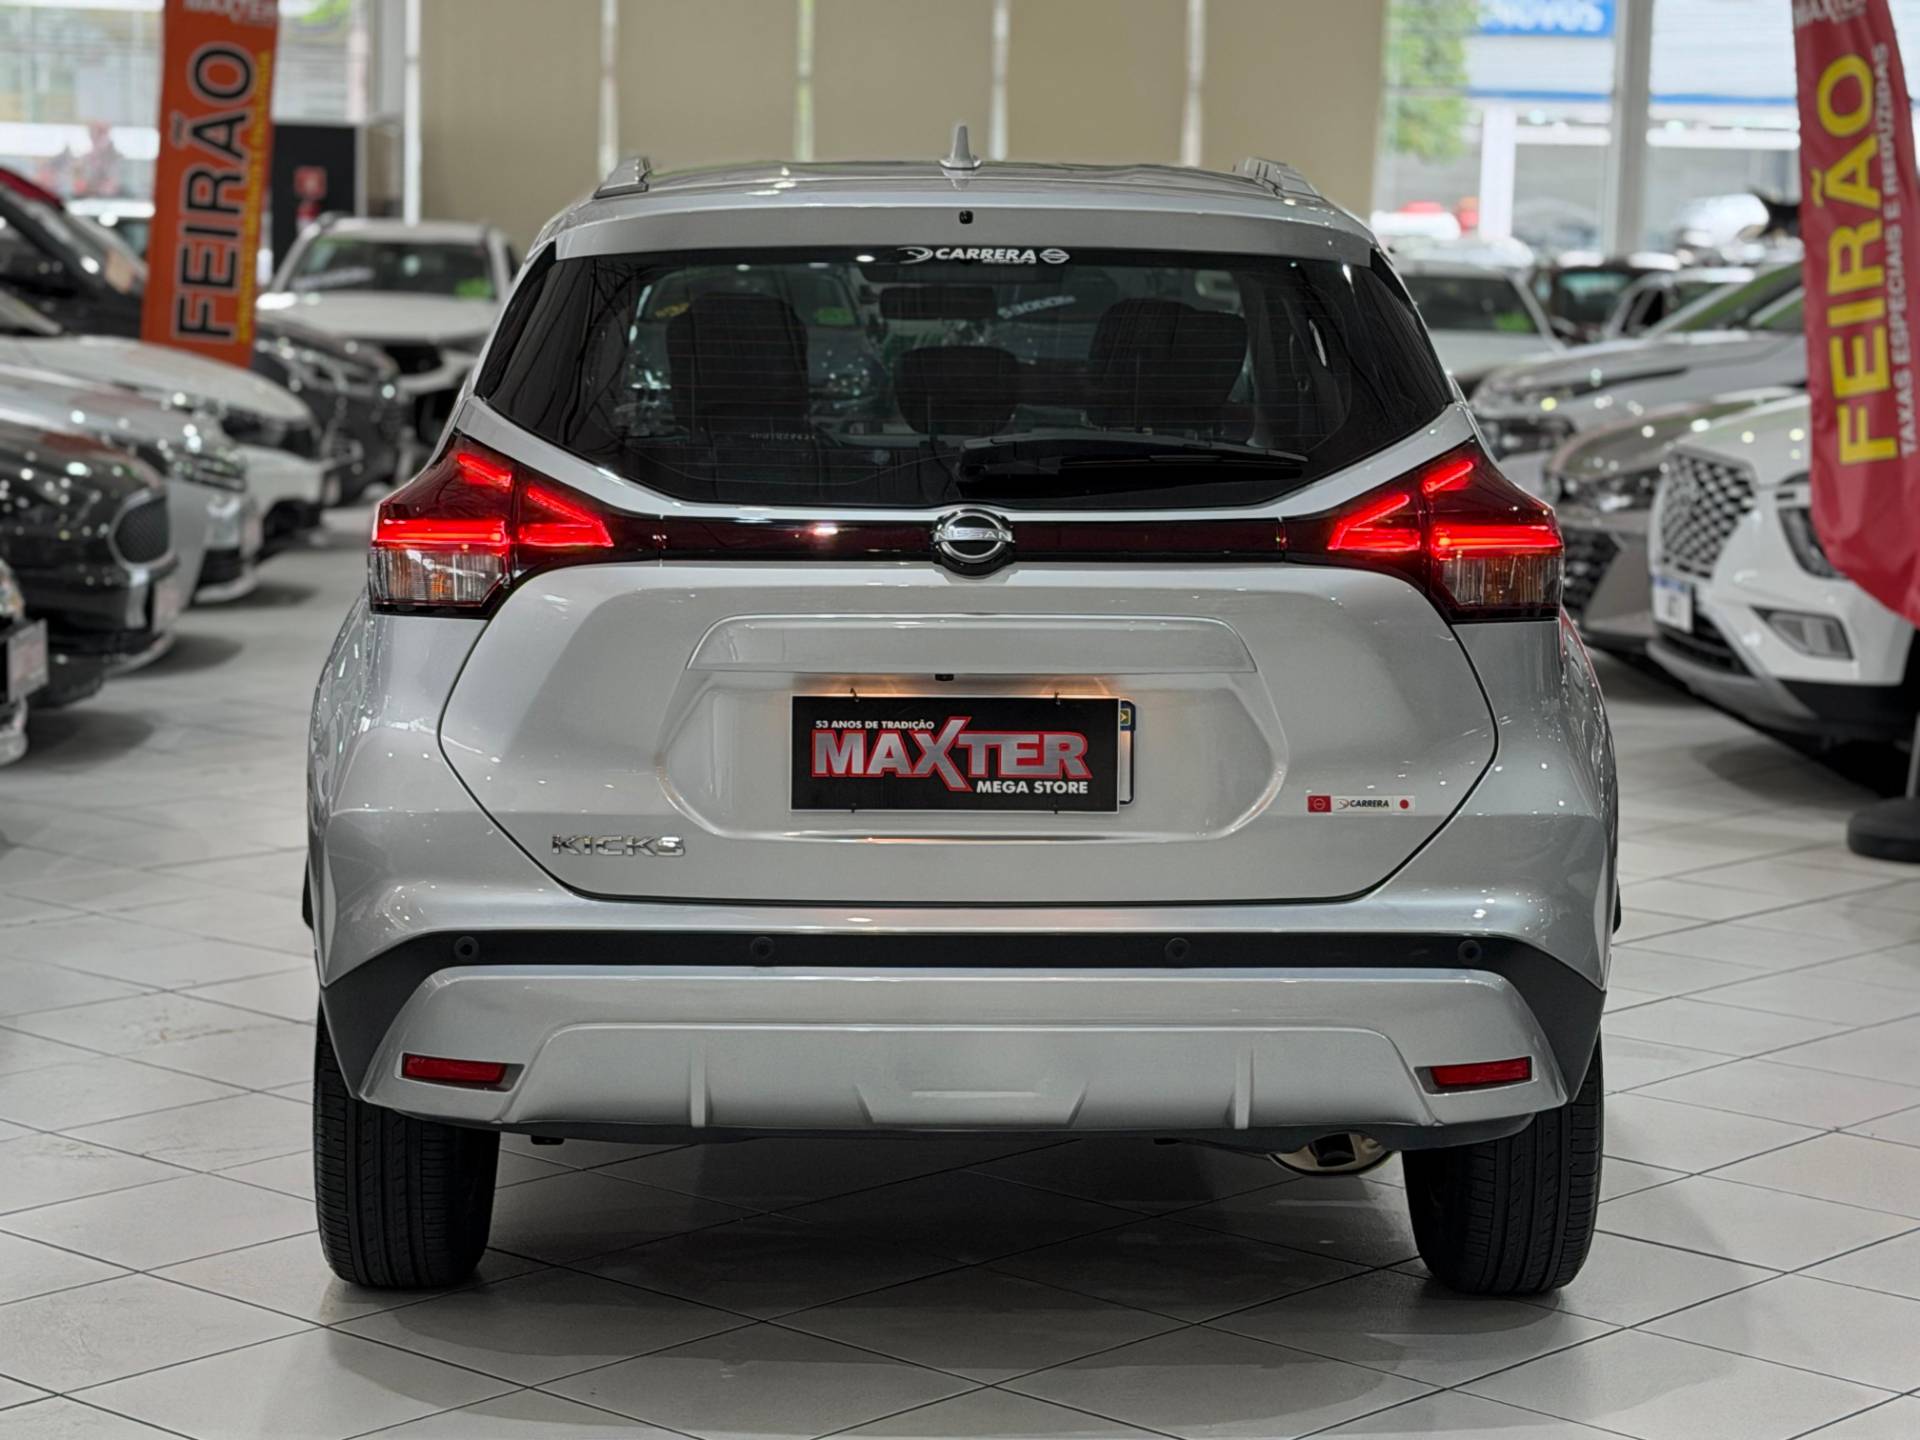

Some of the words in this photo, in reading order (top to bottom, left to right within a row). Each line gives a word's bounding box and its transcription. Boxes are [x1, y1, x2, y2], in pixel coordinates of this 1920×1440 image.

[171, 42, 254, 342] FEIRÃO
[1883, 201, 1901, 220] E
[935, 248, 1036, 260] CARRERA
[1811, 54, 1897, 465] FEIRÃO
[1885, 224, 1911, 364] ESPECIAIS
[1893, 368, 1918, 457] TAXAS
[815, 720, 828, 729] 53
[831, 720, 862, 729] ANOS
[865, 720, 879, 729] DE
[881, 719, 935, 731] TRADIÇÃO
[811, 716, 1092, 792] MAXTER
[976, 781, 1029, 794] MEGA
[1034, 781, 1089, 794] STORE
[1350, 800, 1389, 808] CARRERA
[552, 834, 686, 856] KICKS
